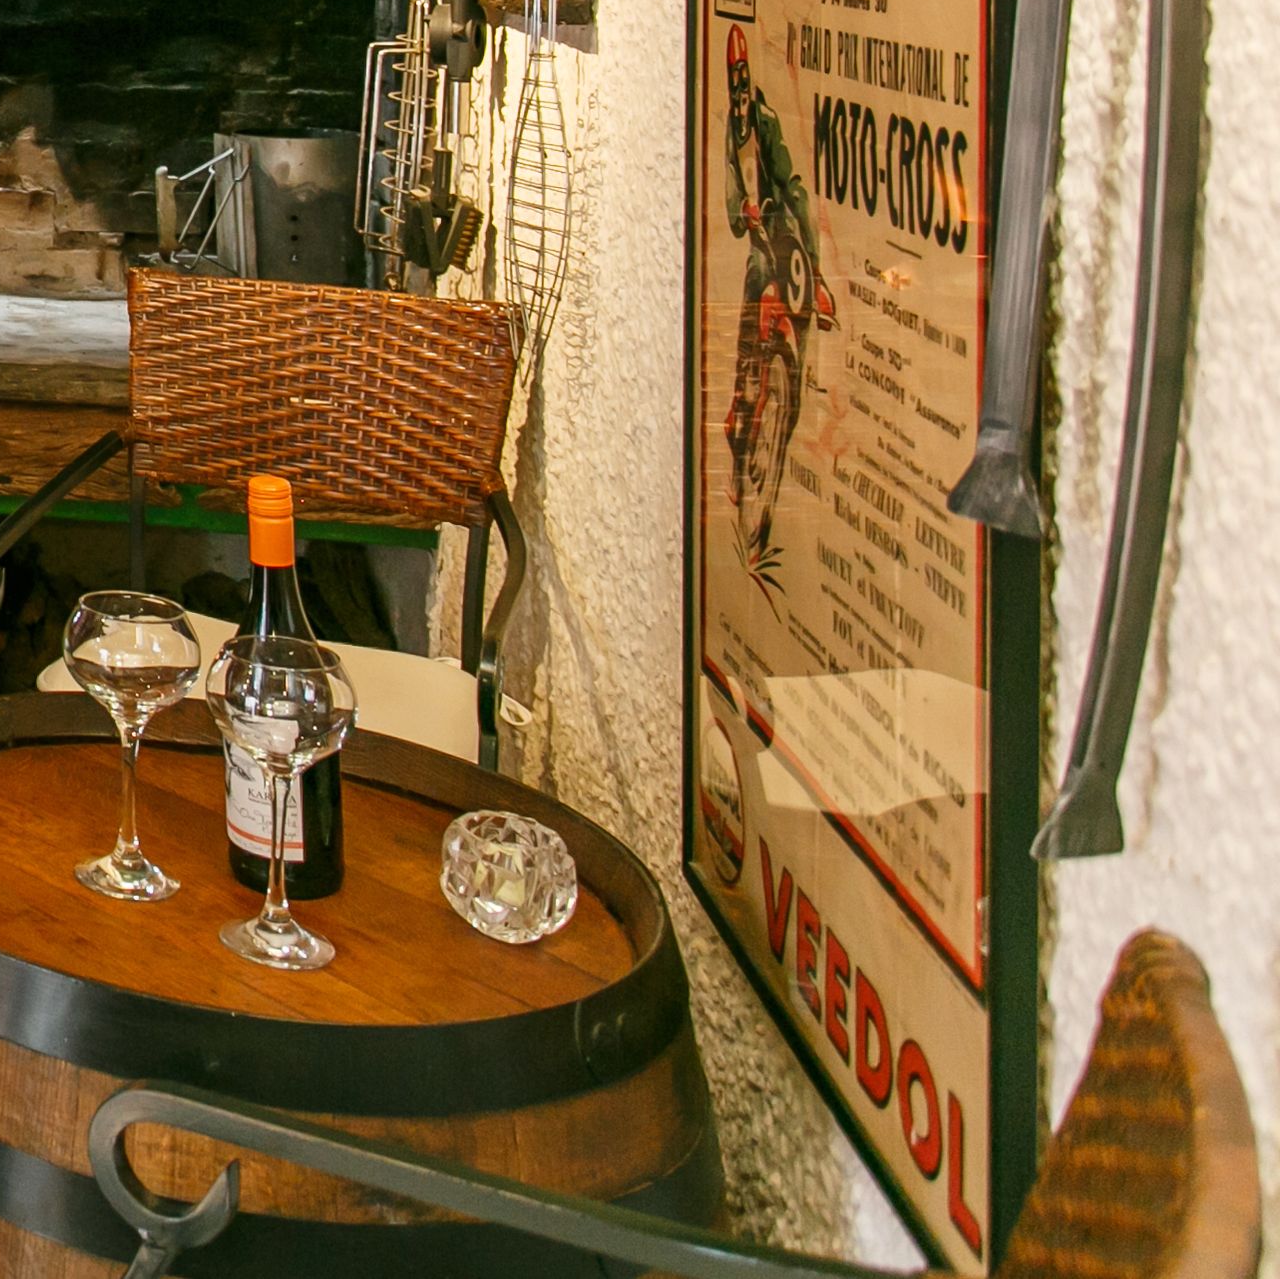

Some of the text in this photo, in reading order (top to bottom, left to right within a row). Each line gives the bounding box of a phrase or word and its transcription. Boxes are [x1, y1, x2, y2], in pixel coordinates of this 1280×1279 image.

[862, 33, 947, 103] INTERNATIONAL
[953, 52, 970, 108] DE
[812, 91, 969, 255] MOTO-CROSS
[758, 834, 984, 1262] VEEDOL
